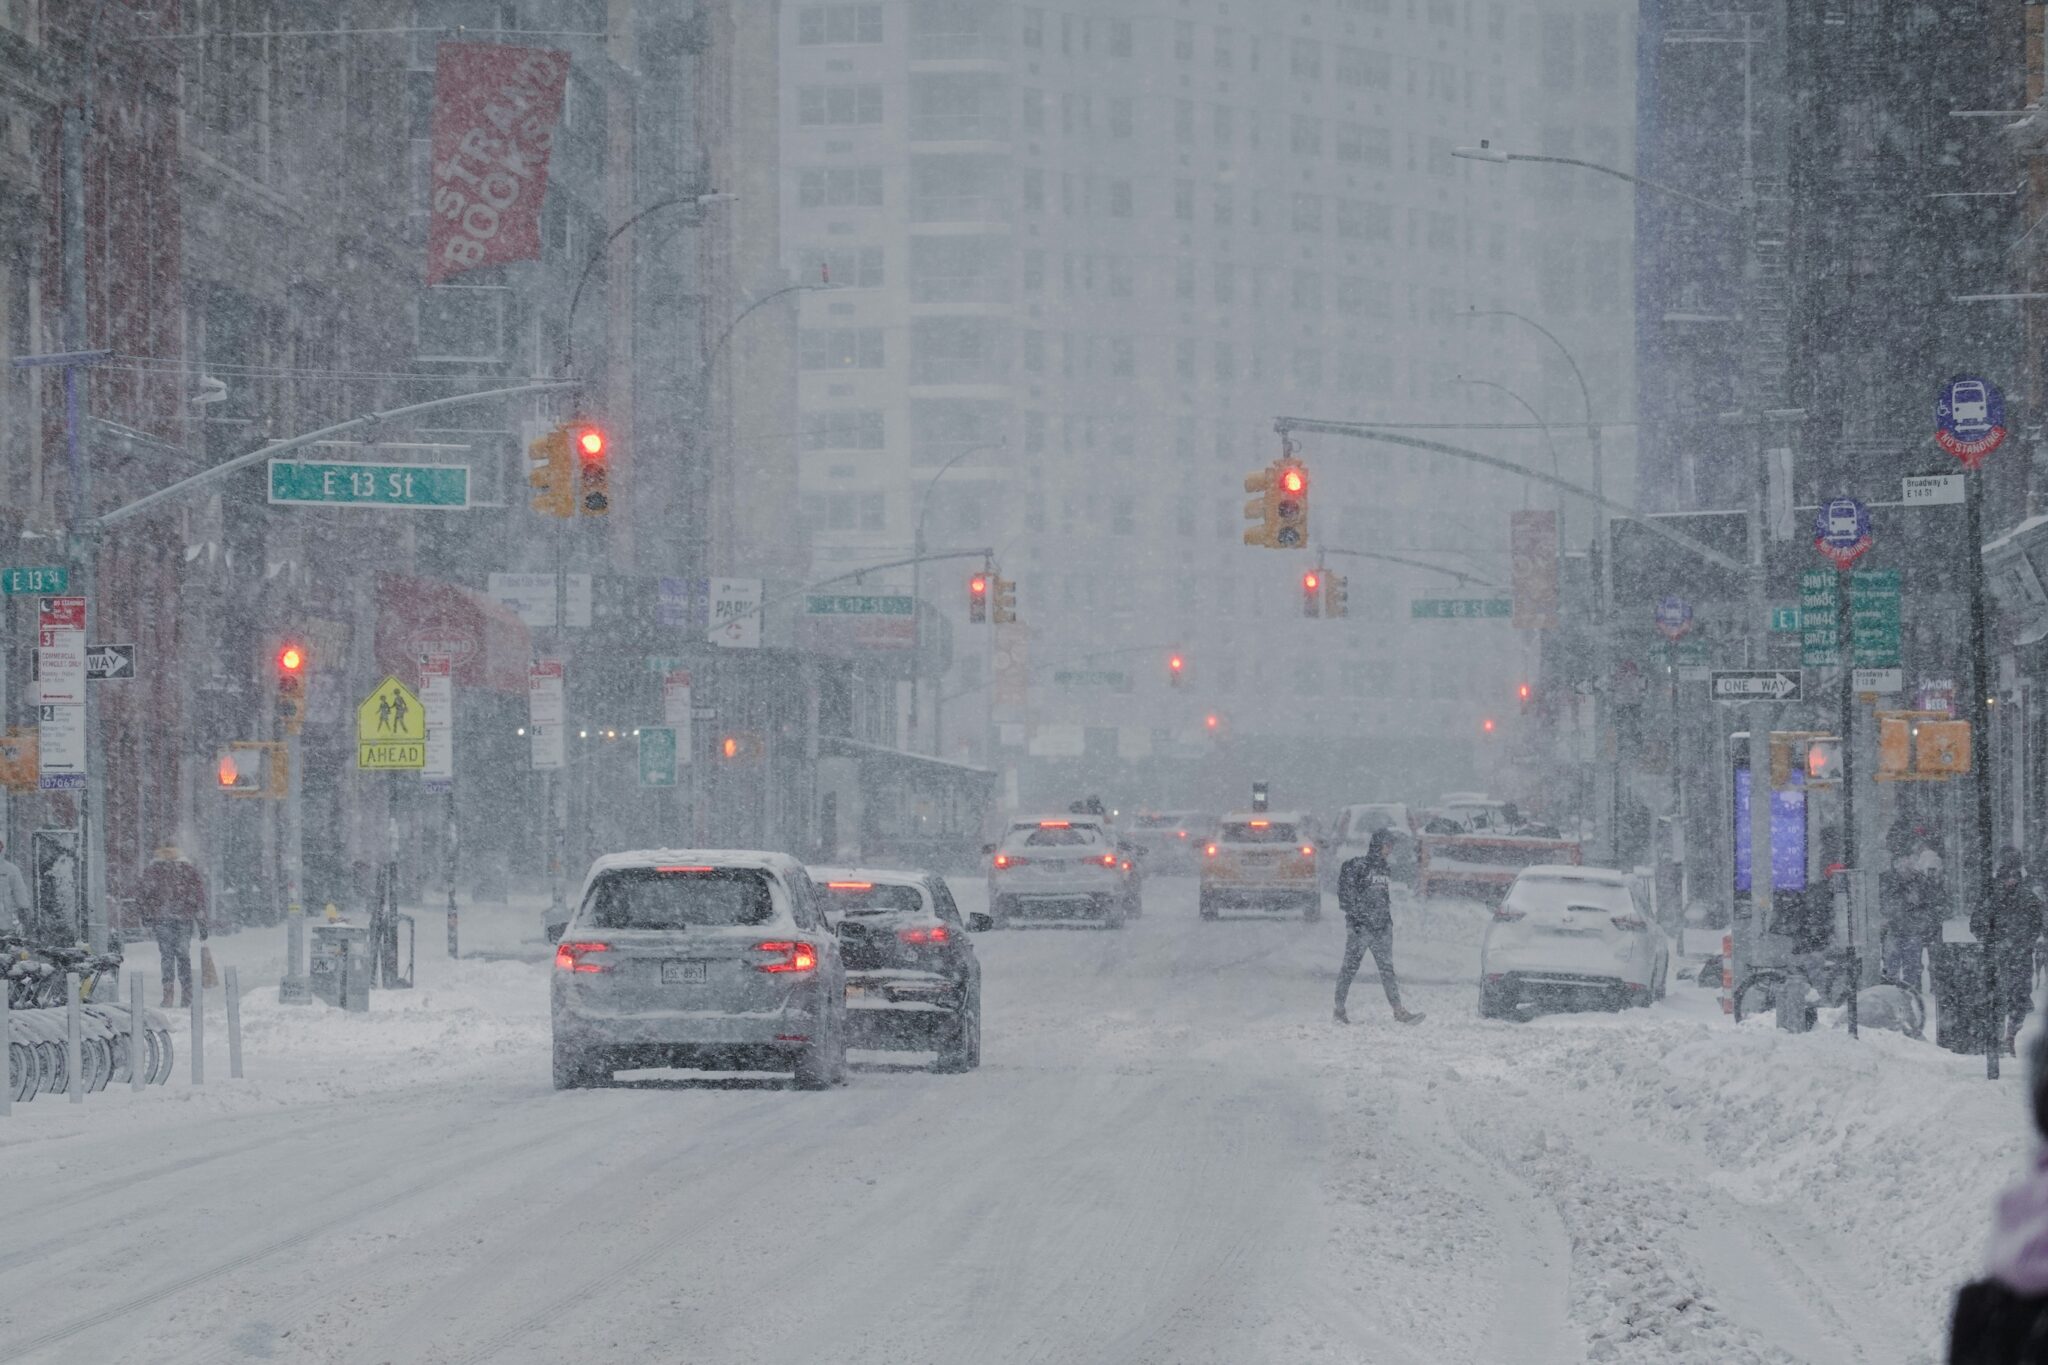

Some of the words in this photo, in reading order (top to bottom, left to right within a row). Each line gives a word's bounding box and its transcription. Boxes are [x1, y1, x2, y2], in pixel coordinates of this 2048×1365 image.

[434, 51, 561, 220] STRAND
[444, 115, 553, 268] BOOKS
[1940, 432, 1954, 448] NO
[1954, 429, 2000, 454] STANDING
[323, 471, 336, 496] E
[350, 472, 375, 497] 13
[388, 472, 414, 498] St
[1906, 478, 1941, 488] Broadway
[1907, 490, 1911, 498] E
[13, 571, 21, 591] E
[28, 570, 42, 590] 13
[715, 600, 753, 619] PARK
[1780, 610, 1788, 628] E
[43, 632, 51, 646] 3
[88, 655, 119, 669] WAY
[1723, 679, 1749, 692] ONE
[1761, 679, 1787, 692] WAY
[1925, 698, 1948, 710] BEER
[43, 706, 51, 720] 2
[366, 747, 418, 763] AHEAD
